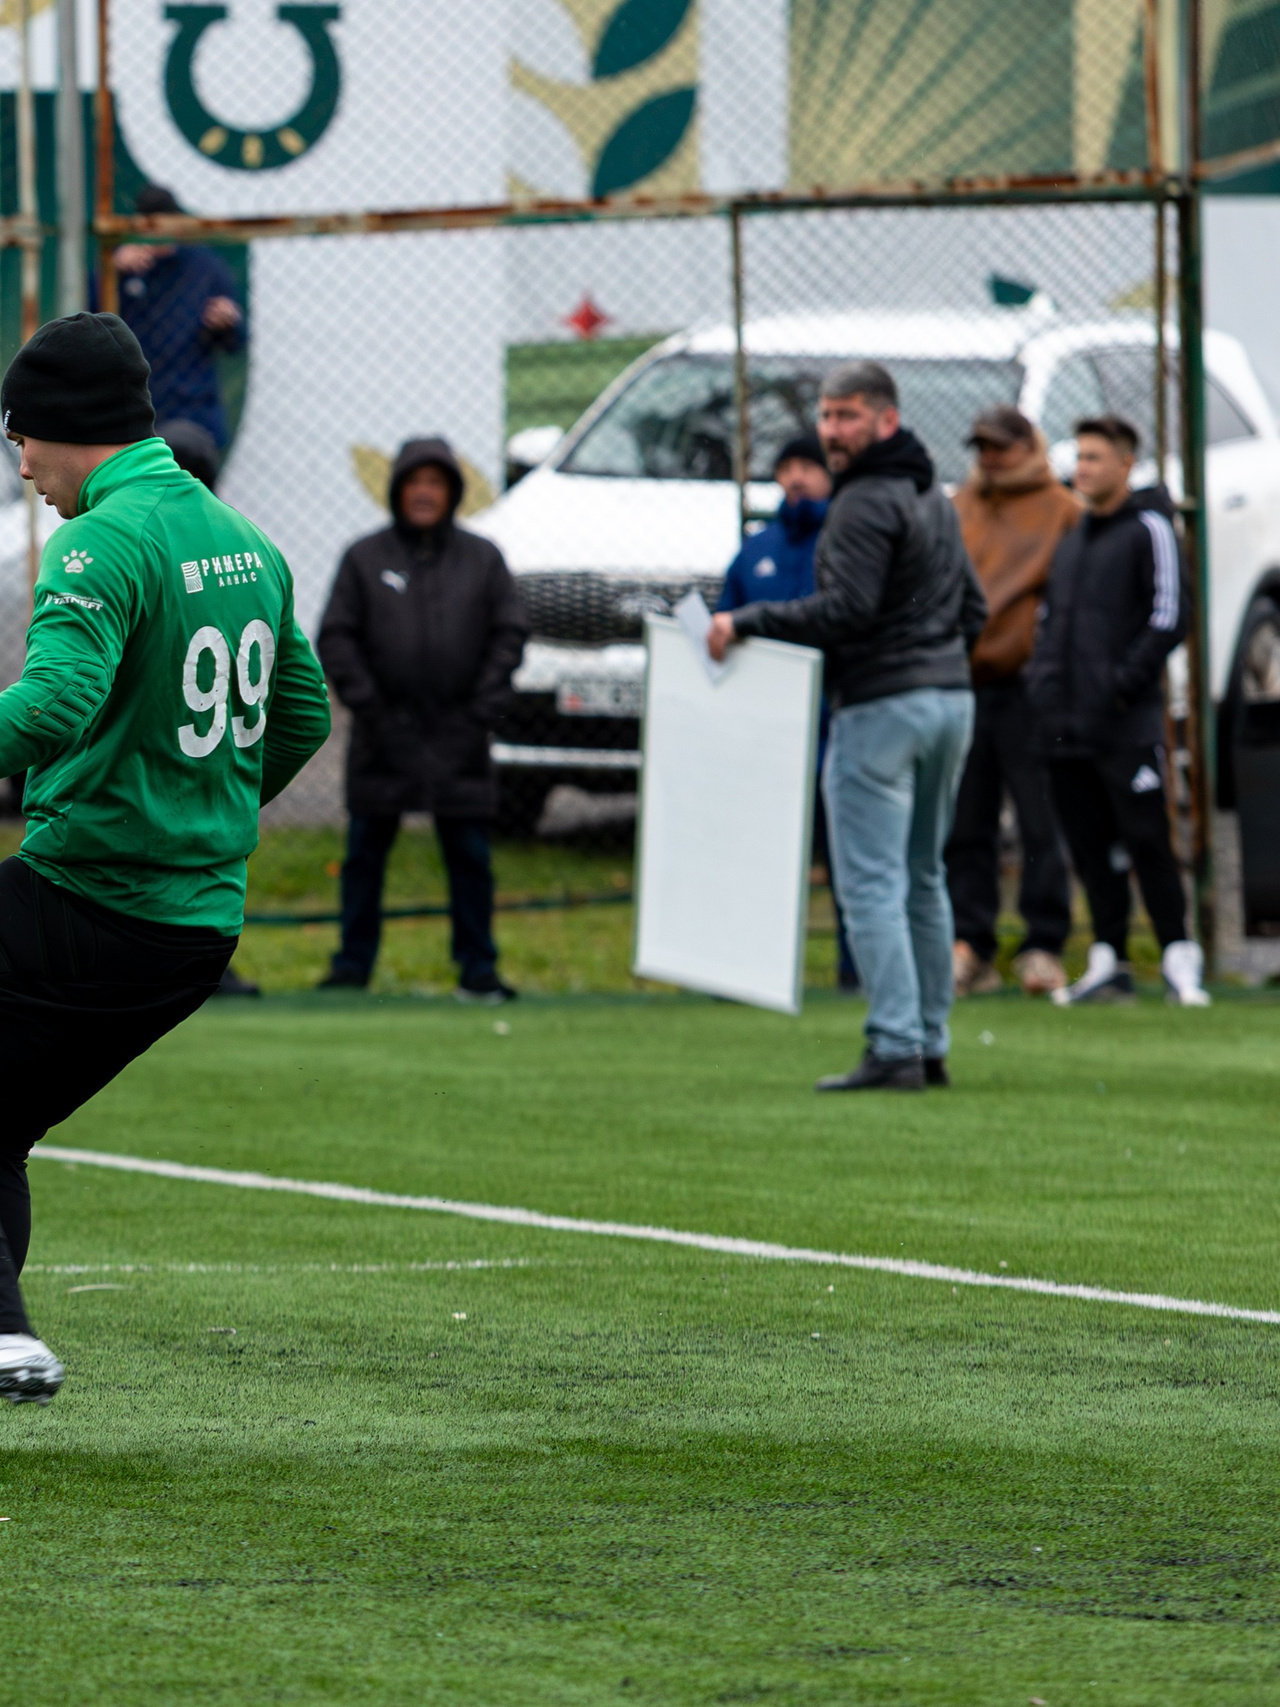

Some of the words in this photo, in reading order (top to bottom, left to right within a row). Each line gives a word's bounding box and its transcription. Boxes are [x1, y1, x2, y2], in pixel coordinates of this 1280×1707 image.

[201, 552, 263, 577] РИМЕРА
[53, 596, 104, 611] TATNEFT
[178, 618, 275, 758] 99
